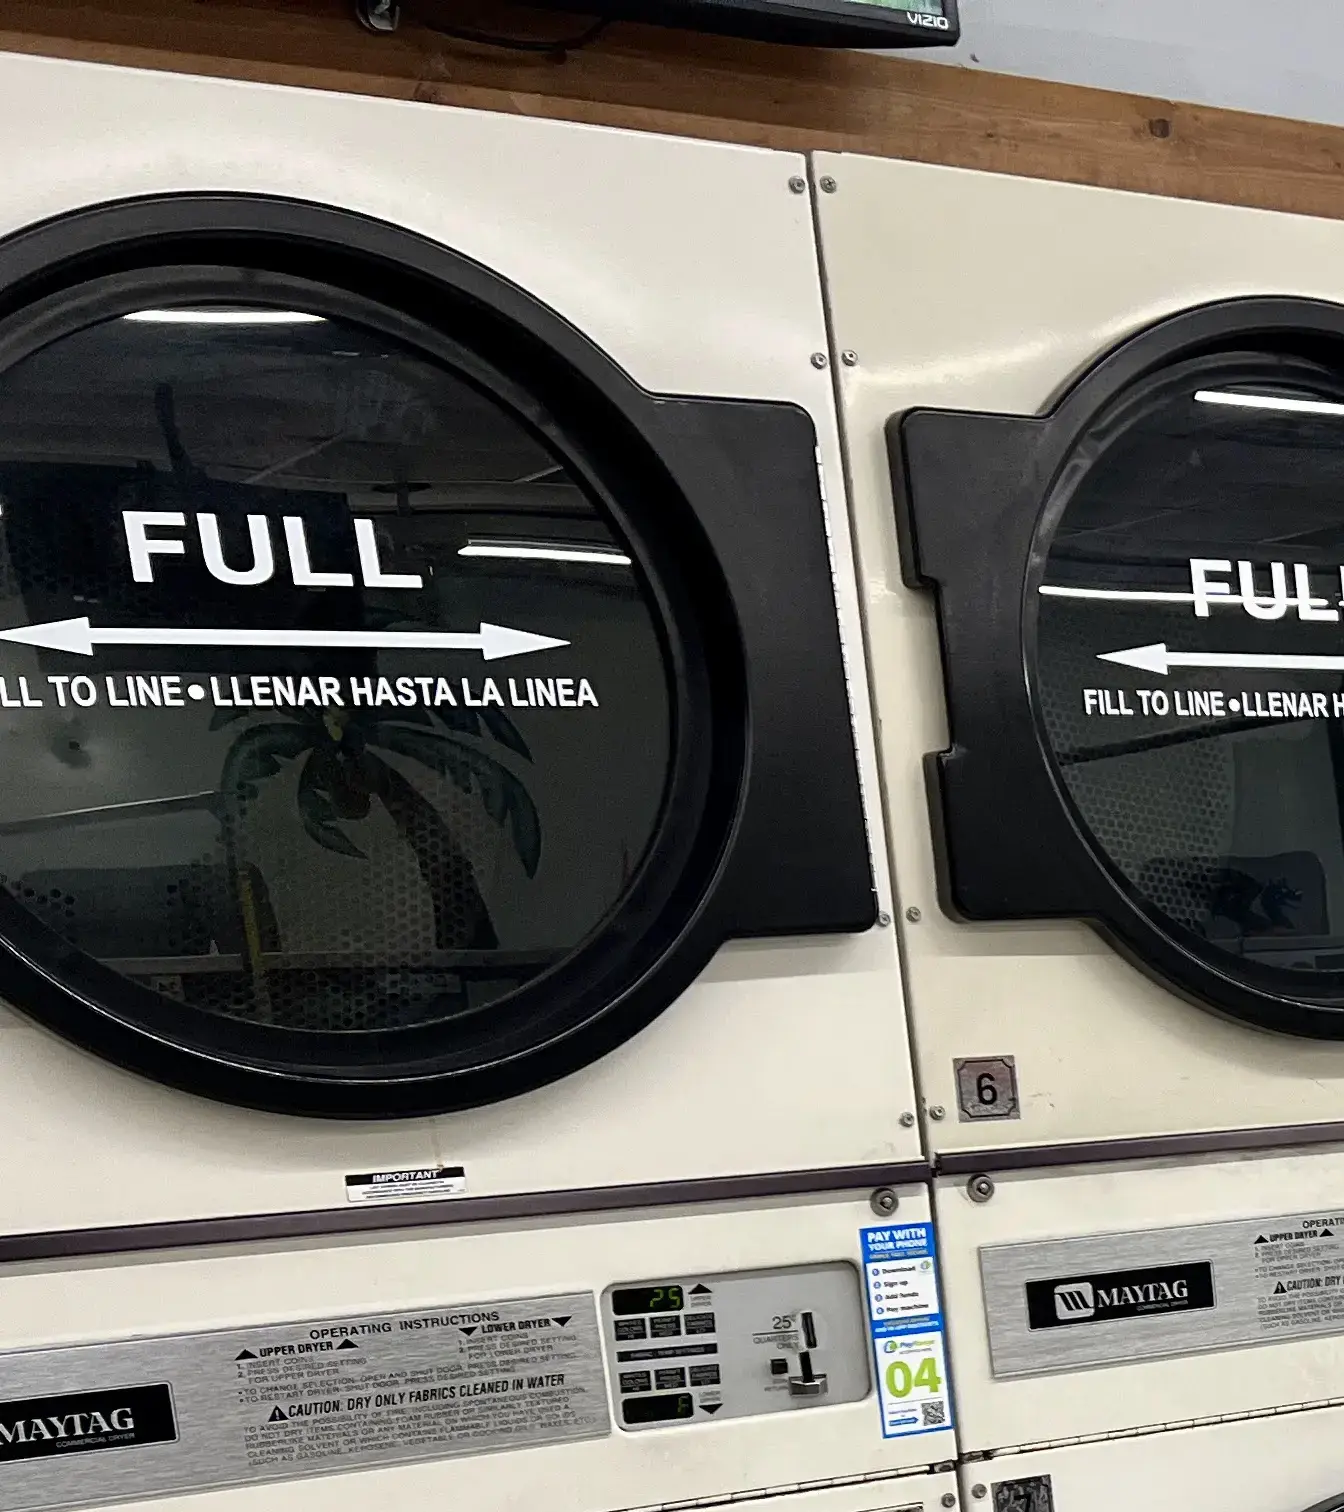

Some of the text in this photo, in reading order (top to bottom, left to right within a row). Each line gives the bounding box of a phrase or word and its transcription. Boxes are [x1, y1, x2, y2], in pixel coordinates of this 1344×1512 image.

[907, 11, 948, 30] VIZIO
[122, 510, 423, 588] FULL
[0, 676, 599, 708] LL TO LINE LLENAR HASTA LA LINEA
[1083, 689, 1134, 716] FILL
[1136, 690, 1168, 716] TO
[1174, 691, 1226, 716] LINE
[1241, 693, 1329, 718] LLENAR
[976, 1072, 998, 1107] 6
[372, 1170, 438, 1183] IMPORTANT
[1097, 1279, 1189, 1311] MAYTAG
[310, 1311, 499, 1340] OPERATING INSTRUCTIONS
[481, 1318, 551, 1334] LOWER DRYER
[259, 1341, 333, 1357] UPPER DRYER
[347, 1396, 370, 1411] DRY
[375, 1392, 406, 1408] ONLY
[409, 1386, 456, 1403] FABRICS
[459, 1380, 508, 1399] CLEANED
[511, 1378, 524, 1393] IN
[527, 1373, 565, 1391] WATER
[886, 1357, 941, 1398] 04
[0, 1407, 135, 1446] MAYTAG
